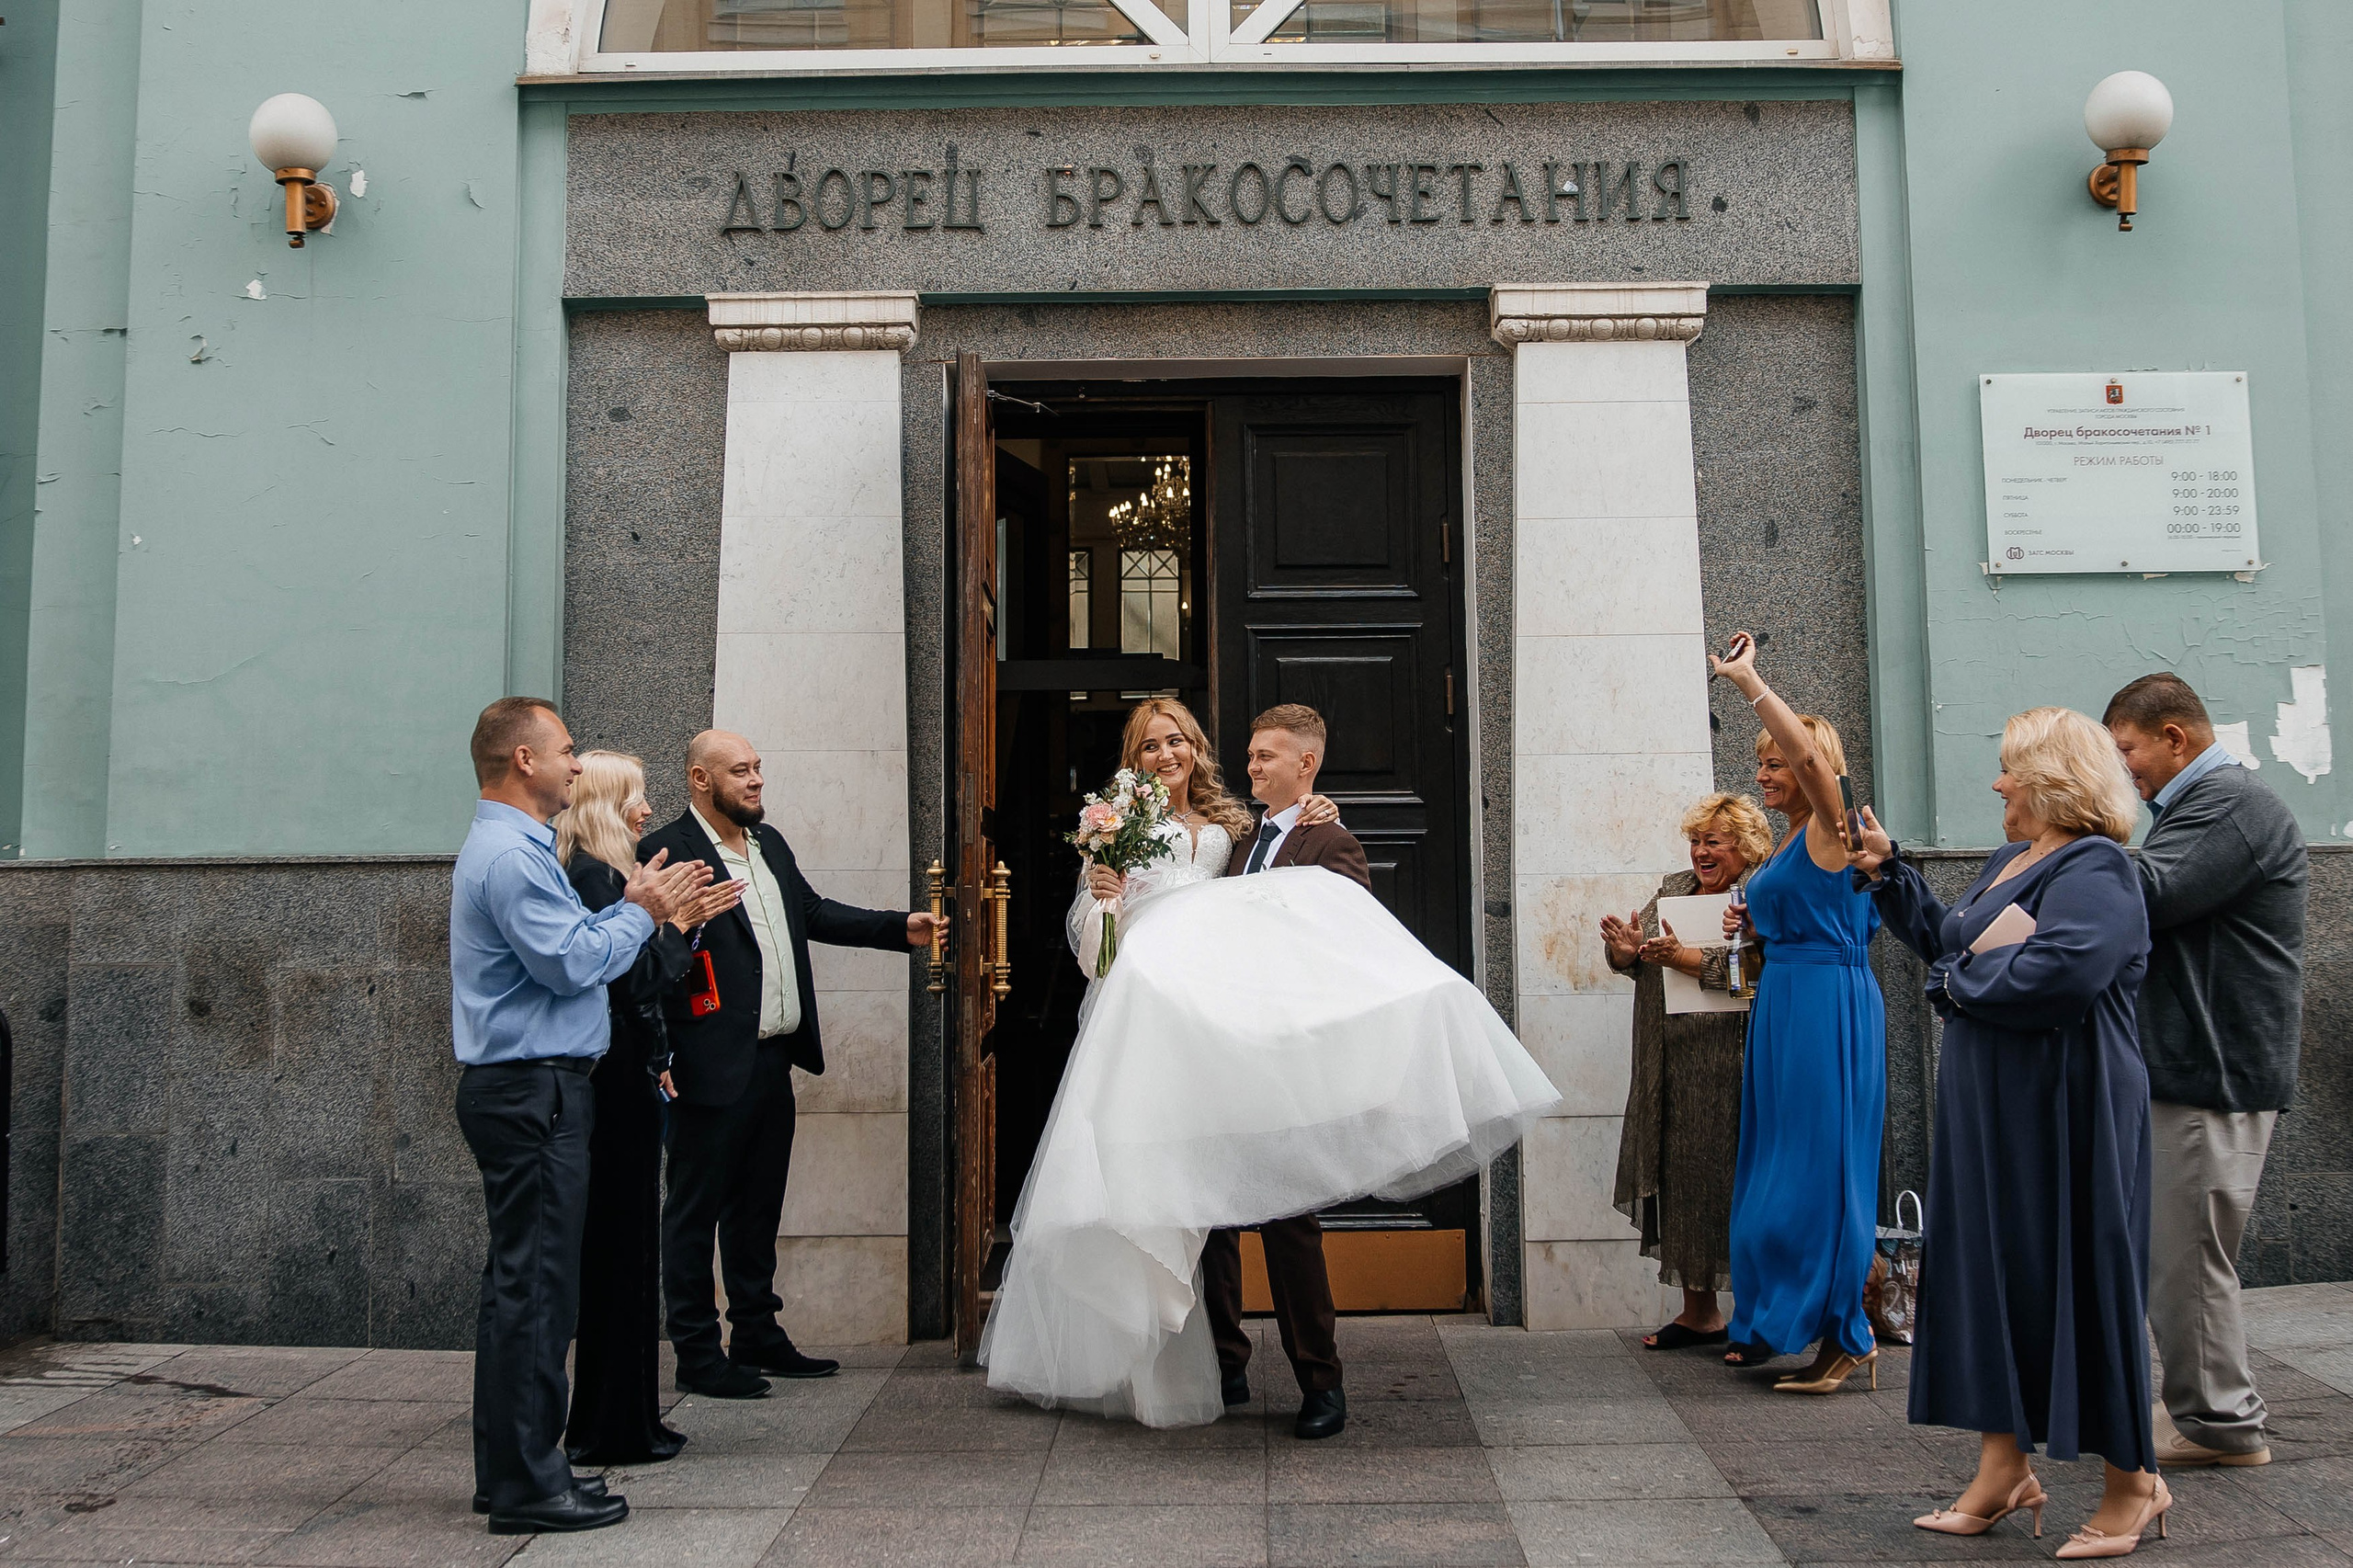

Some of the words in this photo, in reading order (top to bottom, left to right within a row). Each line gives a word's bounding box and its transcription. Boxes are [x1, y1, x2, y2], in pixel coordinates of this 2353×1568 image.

[721, 167, 985, 234] ДВОРЕЦ
[1046, 160, 1689, 228] БРАКОСОЧЕТАНИЯ
[2024, 426, 2073, 439] Дворец
[2076, 426, 2181, 439] бракосочетания
[2185, 426, 2201, 436] №
[2205, 425, 2211, 435] 1
[2074, 456, 2116, 466] РЕЖИМ
[2119, 455, 2164, 465] РАБОТЫ
[2171, 472, 2197, 482] 9:00
[2208, 471, 2238, 481] 18:00
[2172, 488, 2198, 498] 9:00
[2206, 488, 2239, 498] 20:00
[2173, 506, 2199, 516] 9:00
[2208, 505, 2240, 516] 23:59
[2166, 523, 2200, 533] 00:00
[2211, 522, 2241, 533] 19:00
